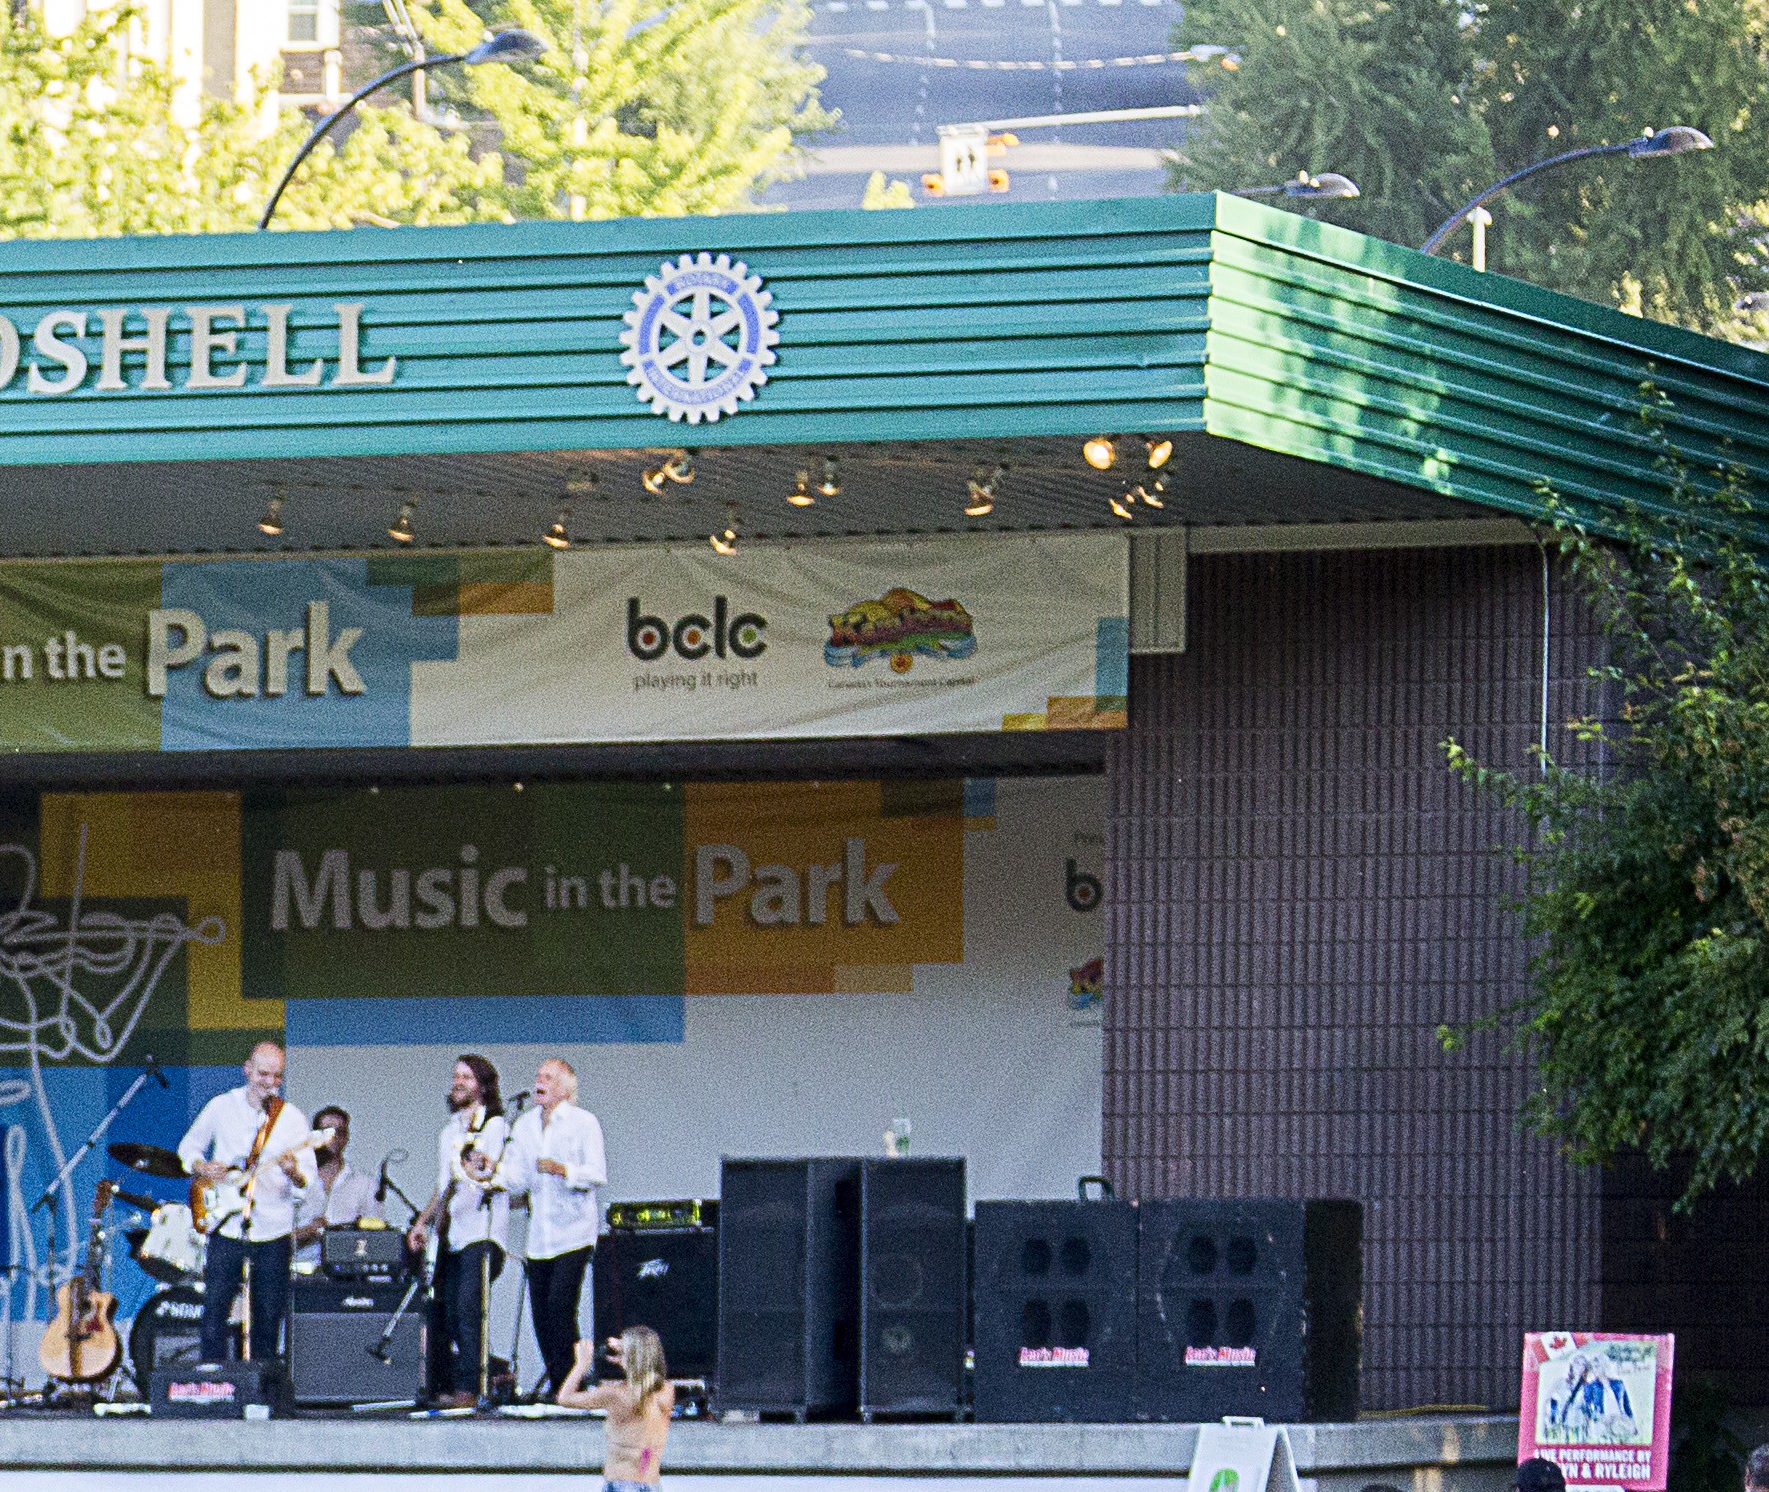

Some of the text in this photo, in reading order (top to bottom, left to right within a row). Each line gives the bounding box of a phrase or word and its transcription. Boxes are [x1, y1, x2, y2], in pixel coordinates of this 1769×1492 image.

[42, 630, 126, 680] the
[146, 600, 366, 699] Park
[626, 594, 769, 662] bclc
[632, 670, 697, 693] playing
[716, 670, 759, 691] right
[268, 838, 900, 932] Music in the Park
[1558, 1448, 1635, 1462] PERFORMANCE
[1636, 1449, 1652, 1461] BY
[1580, 1462, 1593, 1480] &
[1594, 1463, 1652, 1480] RYLEIGH
